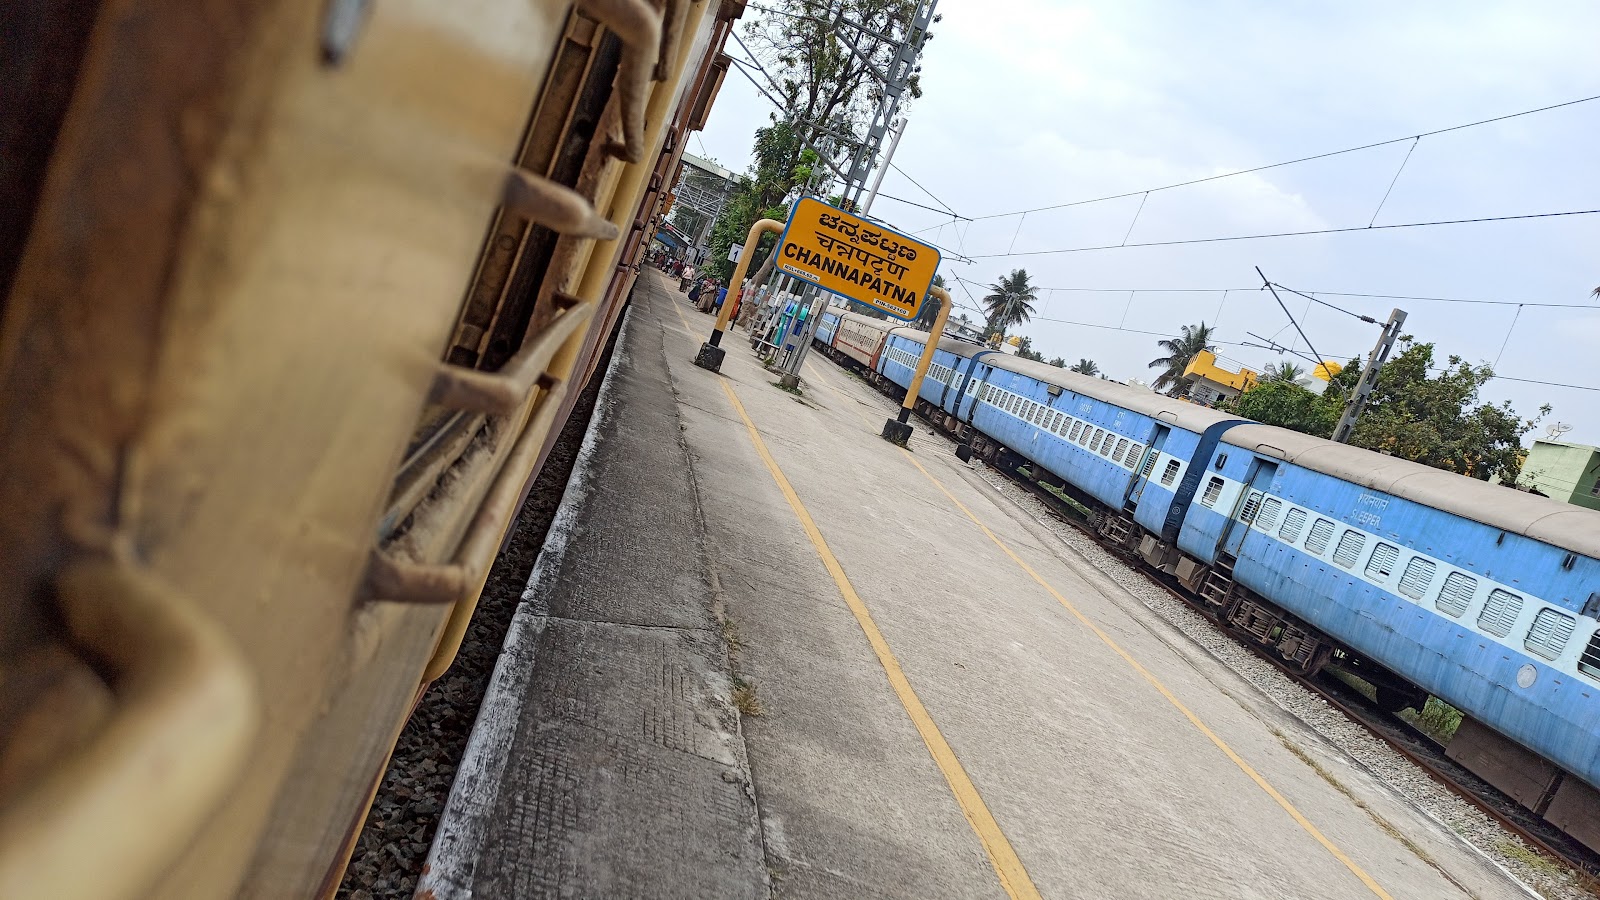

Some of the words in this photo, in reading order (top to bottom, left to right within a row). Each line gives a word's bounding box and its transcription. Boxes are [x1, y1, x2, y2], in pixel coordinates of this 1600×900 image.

[818, 213, 917, 261] ಚನ್ನಪಟ್ಟಣ
[733, 250, 739, 262] 1
[784, 241, 917, 308] CHANNAPATNA
[1357, 493, 1390, 511] शयनयान
[1350, 508, 1382, 528] SLEEPER
